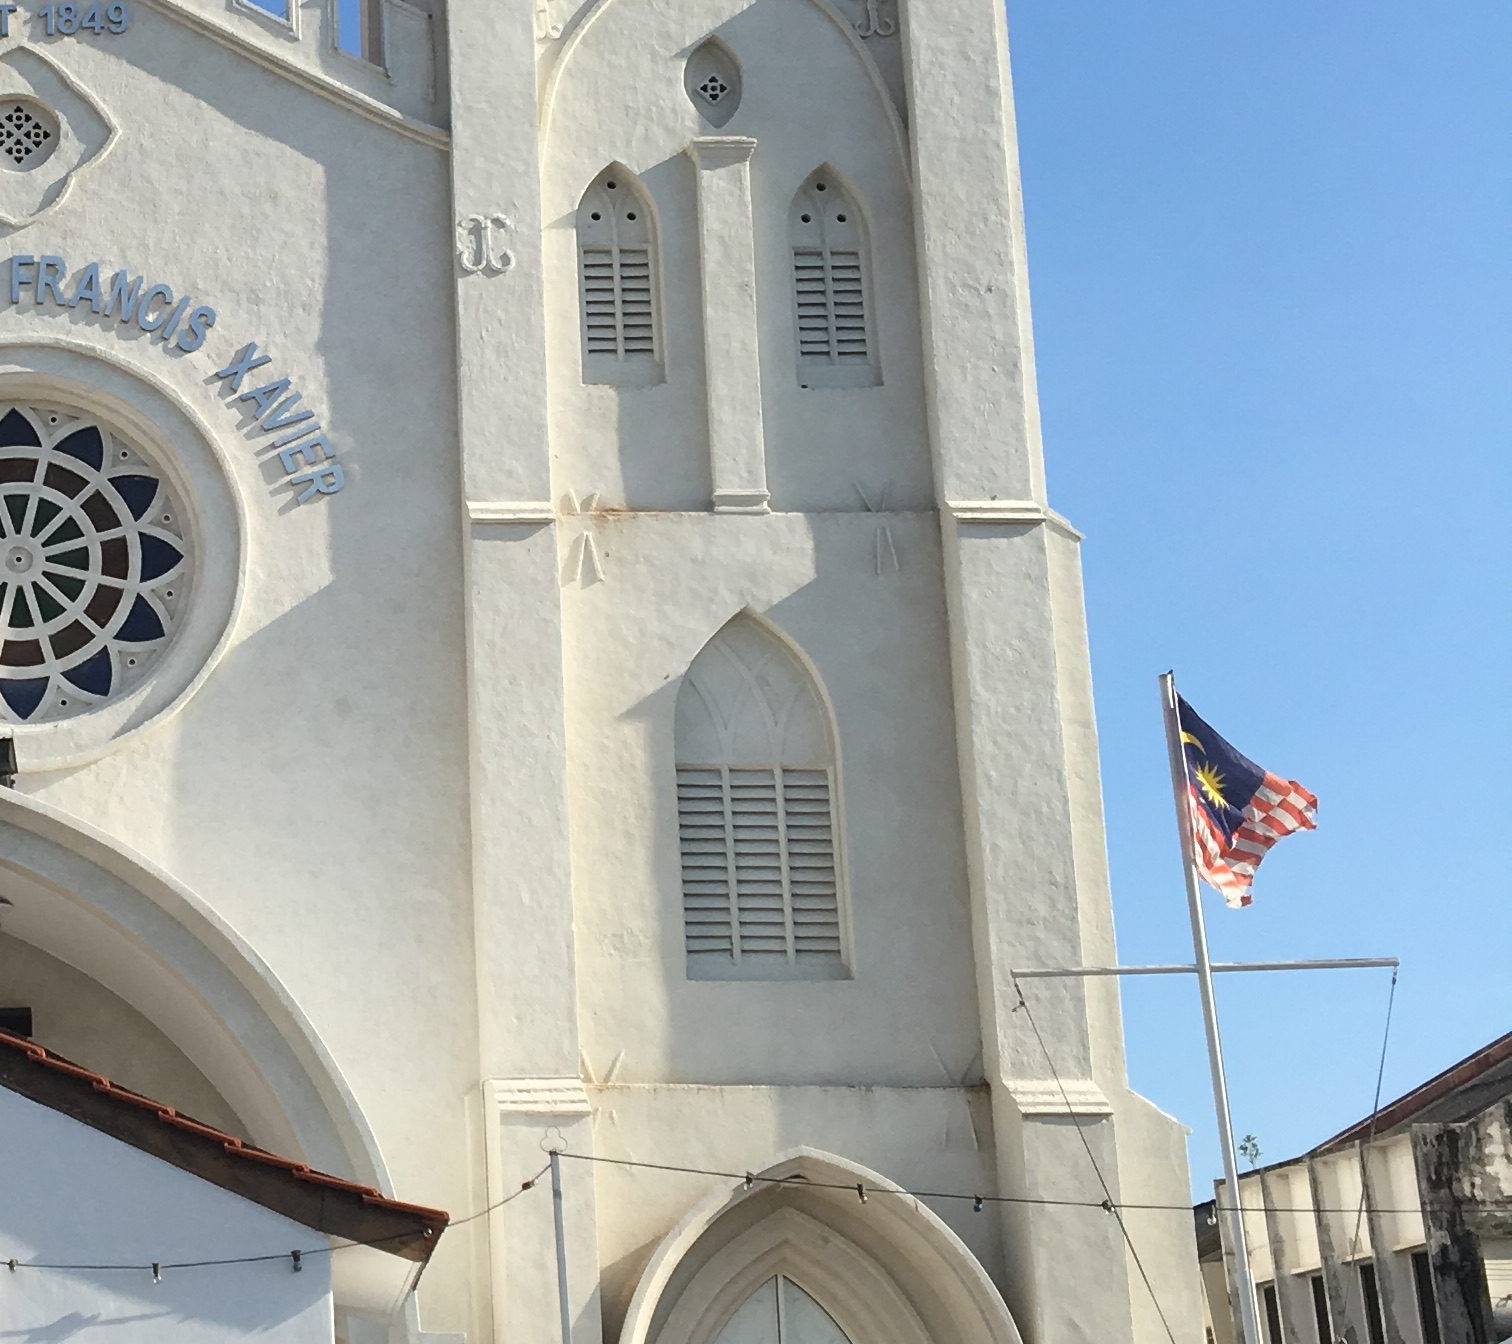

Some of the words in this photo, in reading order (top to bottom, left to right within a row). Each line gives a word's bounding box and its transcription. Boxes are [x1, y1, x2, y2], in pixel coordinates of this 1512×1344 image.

[39, 2, 129, 37] 1849
[10, 254, 217, 353] FRANCIS
[215, 341, 346, 507] XAVIER
